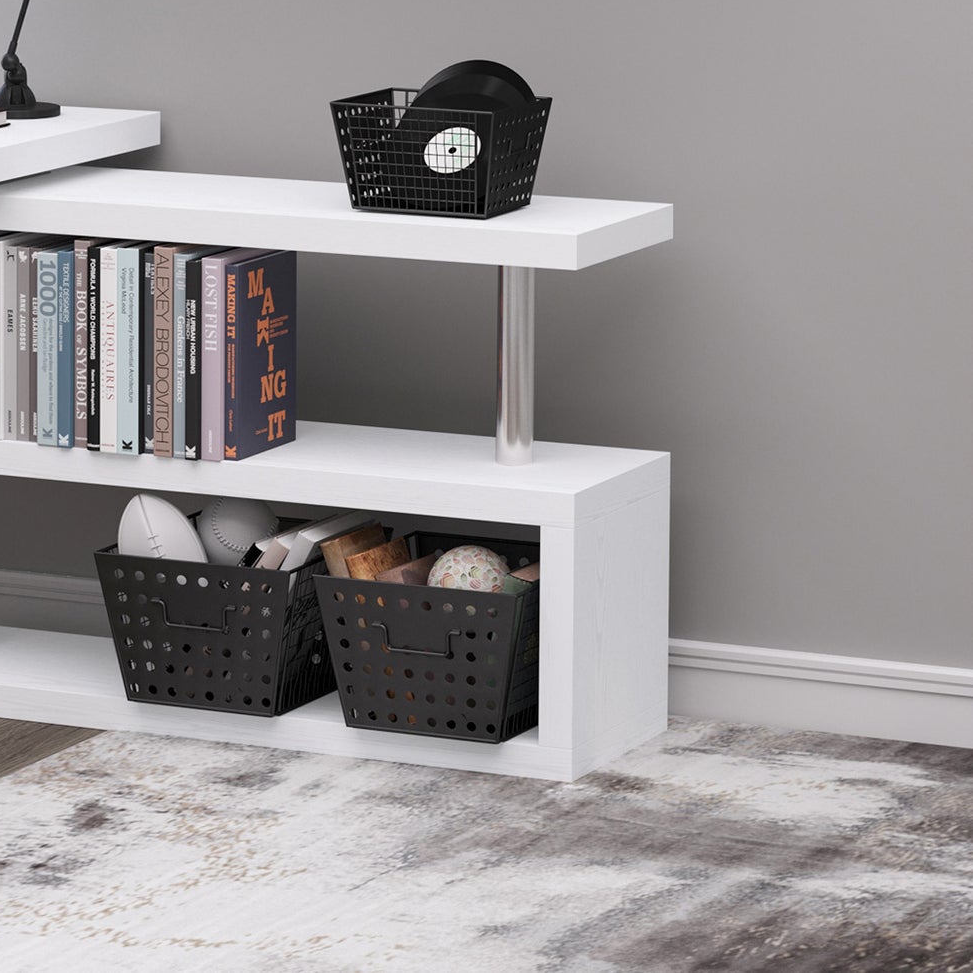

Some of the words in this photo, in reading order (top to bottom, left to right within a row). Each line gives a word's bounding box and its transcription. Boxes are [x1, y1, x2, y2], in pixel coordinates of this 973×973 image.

[40, 260, 56, 317] 1000
[156, 253, 170, 323] ALEXEY
[205, 265, 218, 309] LOST
[227, 274, 236, 323] MAKING
[76, 290, 87, 332] BOOK
[205, 313, 218, 352] FISH
[227, 325, 236, 339] IT
[105, 300, 115, 401] ANTIQUAIRES
[177, 315, 185, 356] Gardens
[76, 347, 87, 420] SYMBOLS
[177, 357, 185, 368] in
[156, 328, 170, 443] BRODOVITCH
[177, 370, 185, 403] France
[267, 410, 286, 441] IT
